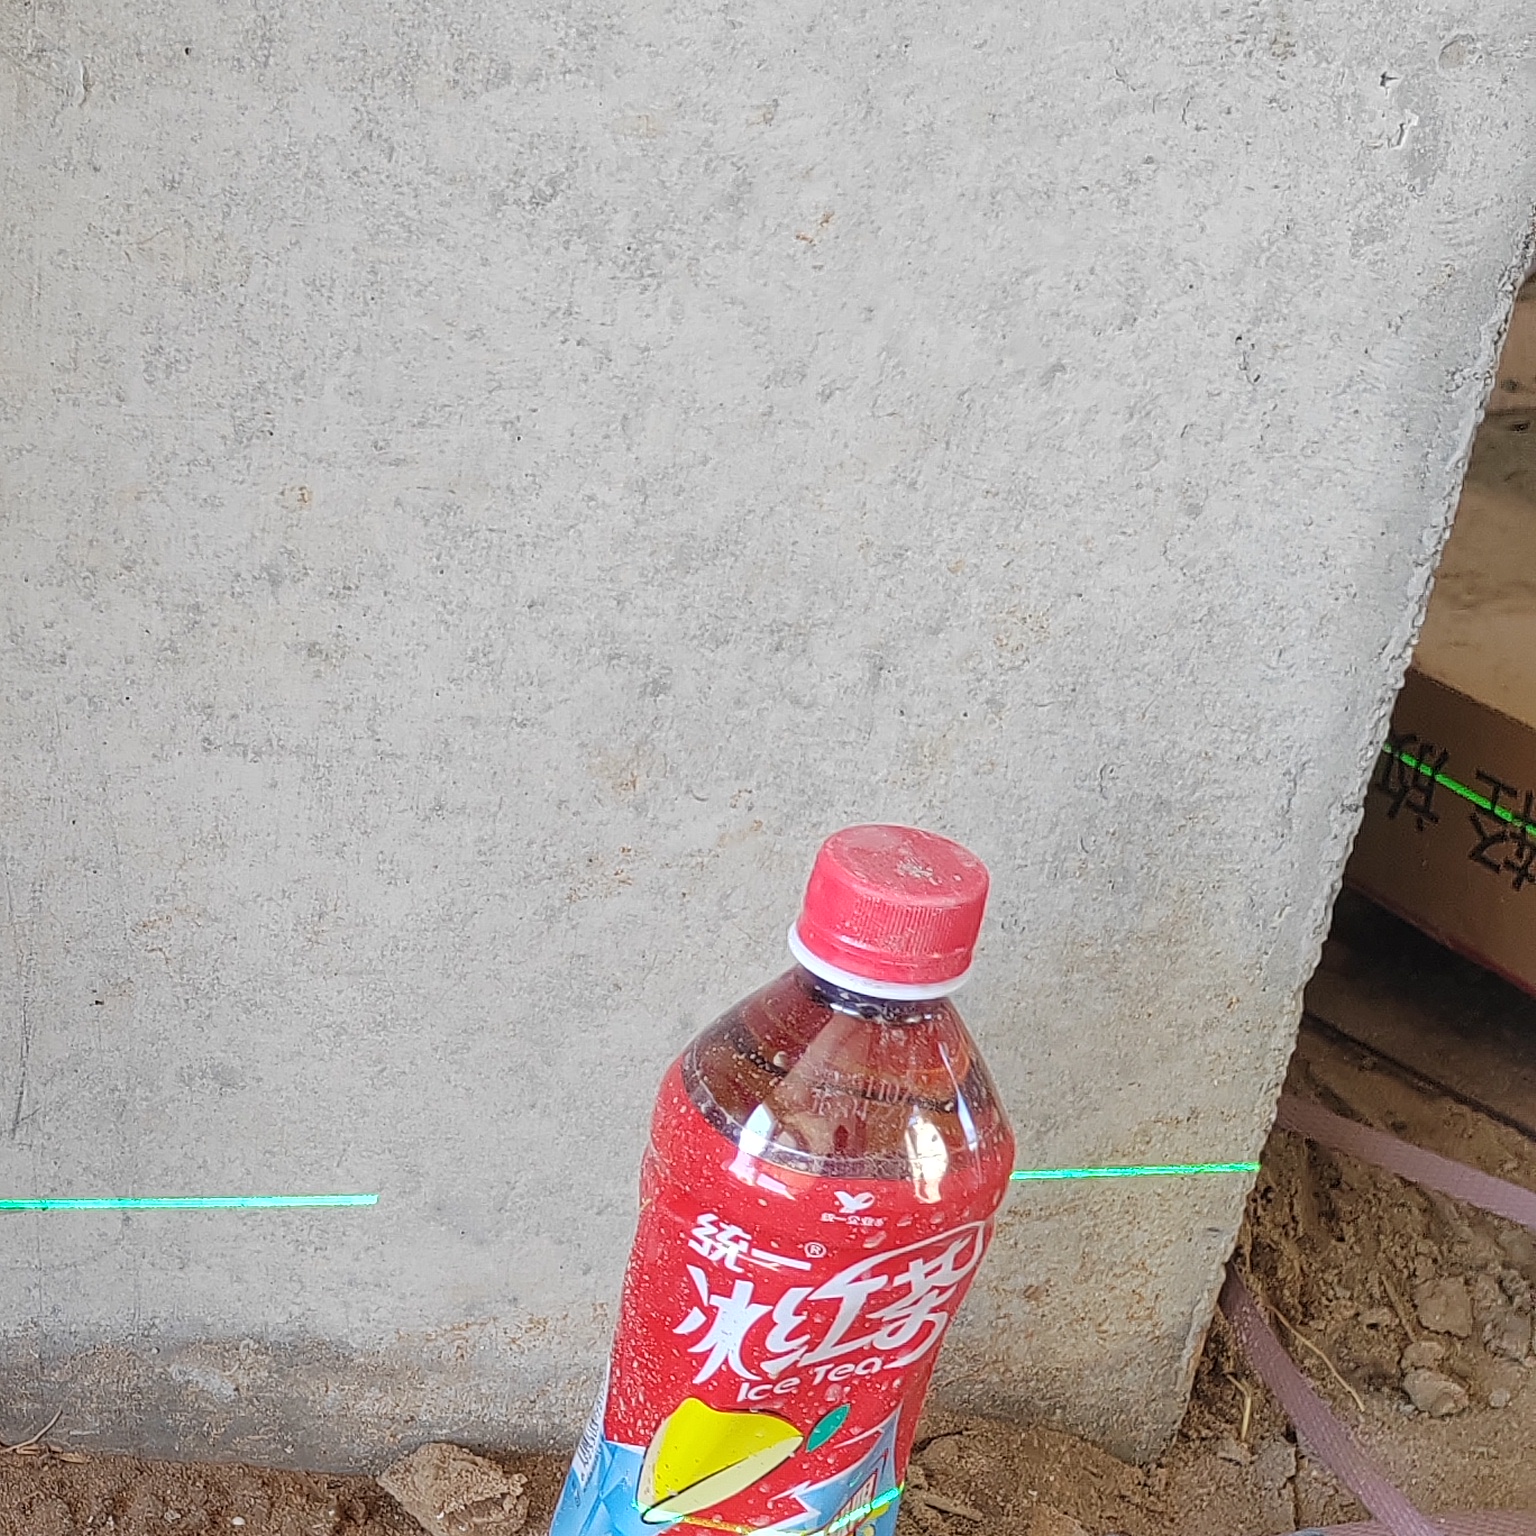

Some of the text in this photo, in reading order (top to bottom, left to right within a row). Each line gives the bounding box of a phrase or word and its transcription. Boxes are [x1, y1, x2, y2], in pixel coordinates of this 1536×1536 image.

[688, 1213, 812, 1273] 统一
[672, 1220, 986, 1384] 冰红茶
[736, 1356, 884, 1402] Ice Tea
